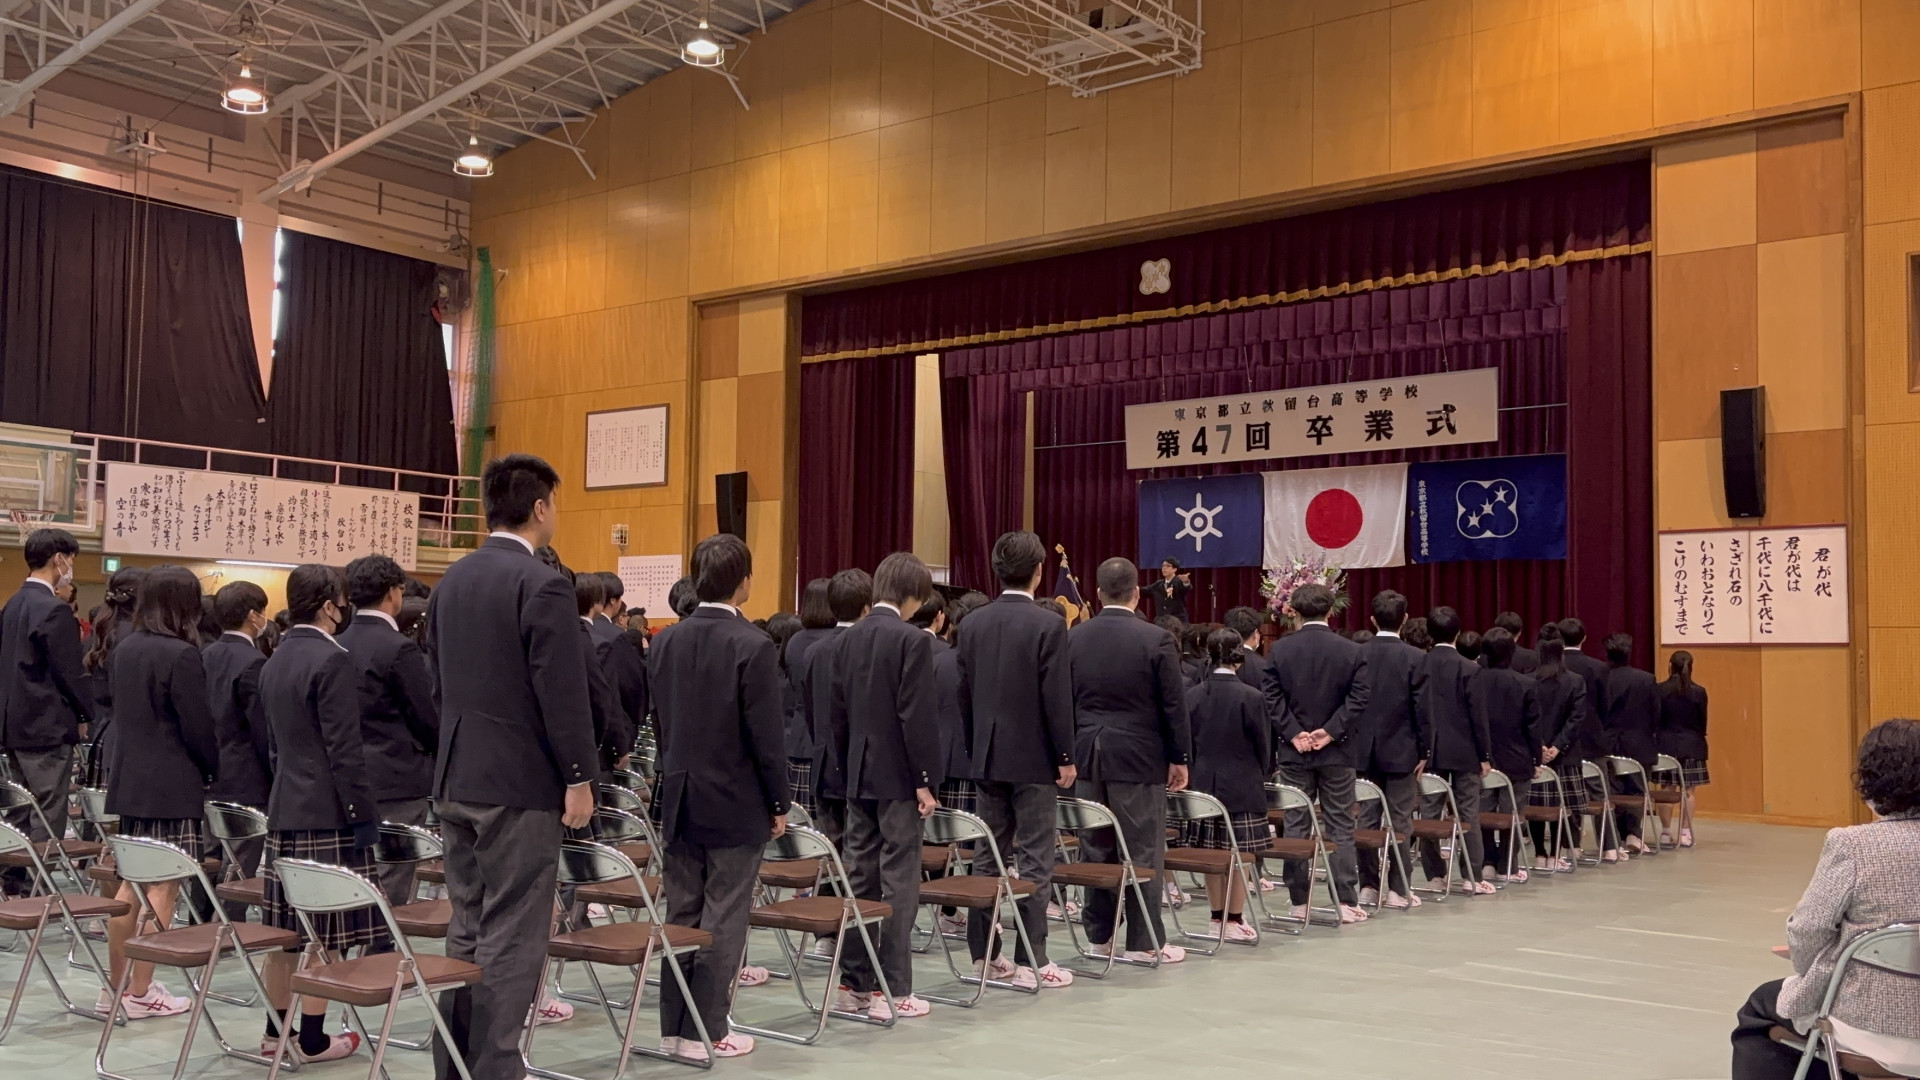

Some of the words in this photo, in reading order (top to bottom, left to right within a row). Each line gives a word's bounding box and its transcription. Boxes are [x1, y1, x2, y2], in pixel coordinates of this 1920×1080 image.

[1174, 384, 1418, 421] 東京都立秋留台高等学校
[1156, 421, 1271, 459] 第47回
[1306, 404, 1457, 445] 卒業式
[113, 497, 127, 537] 空の青
[140, 482, 151, 518] 寒梅の
[192, 504, 201, 542] なりて立つ
[403, 503, 414, 529] 校歌
[1673, 540, 1689, 636] こけのむすまで
[1700, 540, 1715, 635] いわおとなりて
[1726, 538, 1744, 606] さざれ石の
[1756, 536, 1774, 634] 千代に八千代に
[1783, 536, 1802, 592] 君が代は
[1811, 547, 1832, 597] 君が代
